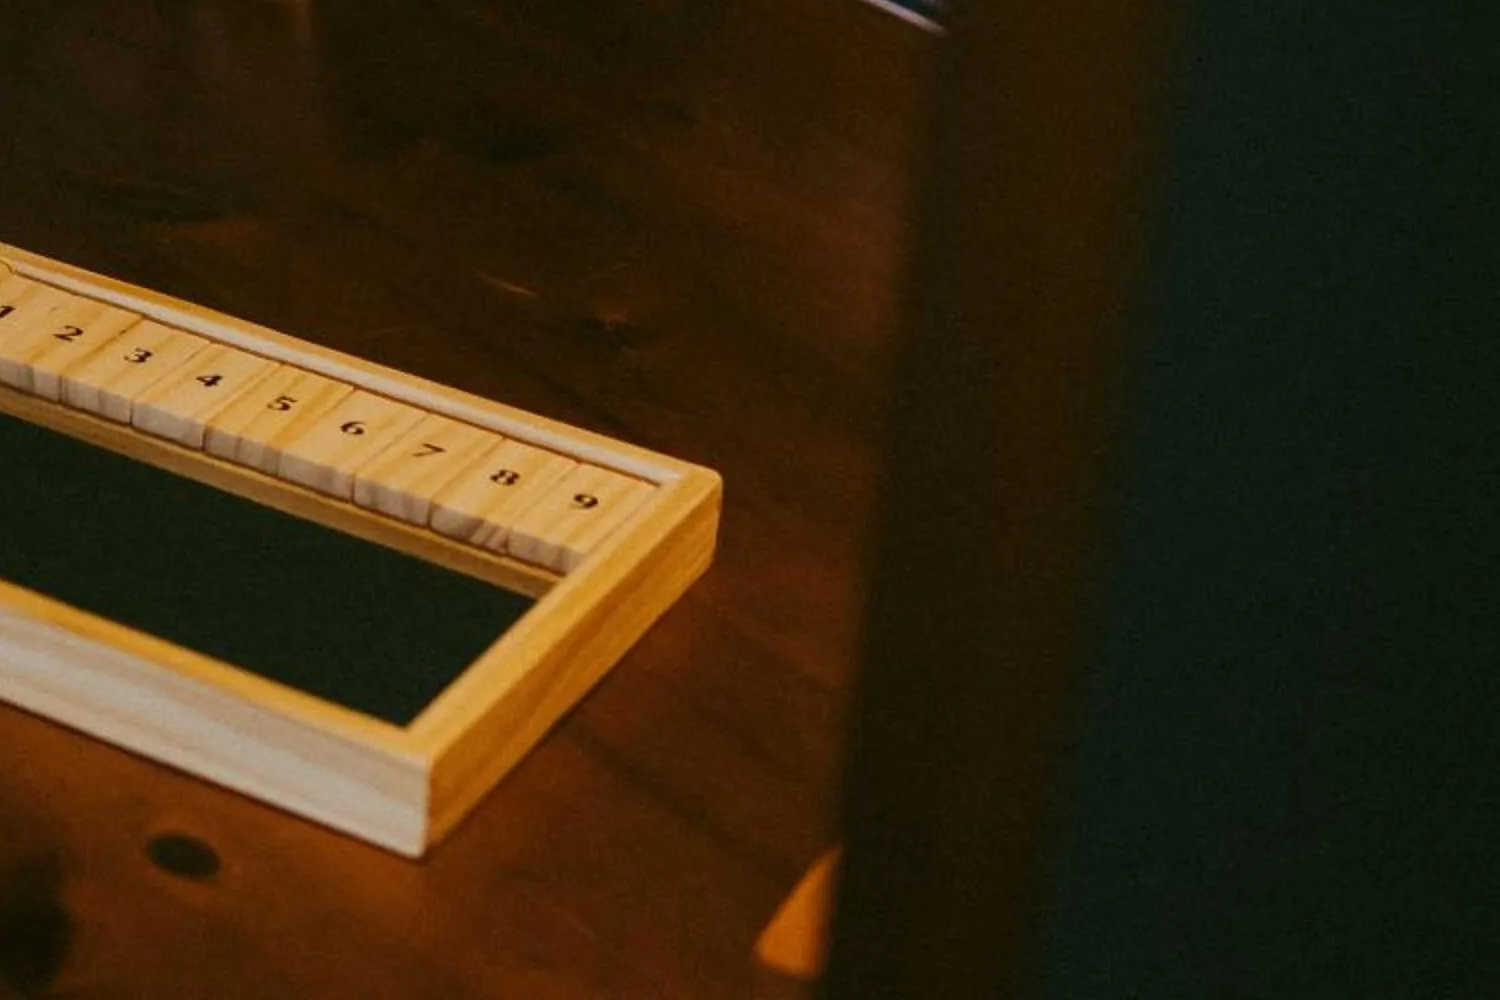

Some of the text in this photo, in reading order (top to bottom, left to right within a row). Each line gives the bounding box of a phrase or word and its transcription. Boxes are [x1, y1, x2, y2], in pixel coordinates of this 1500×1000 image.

[53, 325, 84, 342] 2
[124, 348, 153, 364] 3
[195, 375, 223, 387] 4
[266, 395, 298, 412] 5
[340, 421, 365, 435] 6
[413, 443, 445, 457] 7
[490, 469, 520, 486] 8
[573, 493, 599, 509] 9
